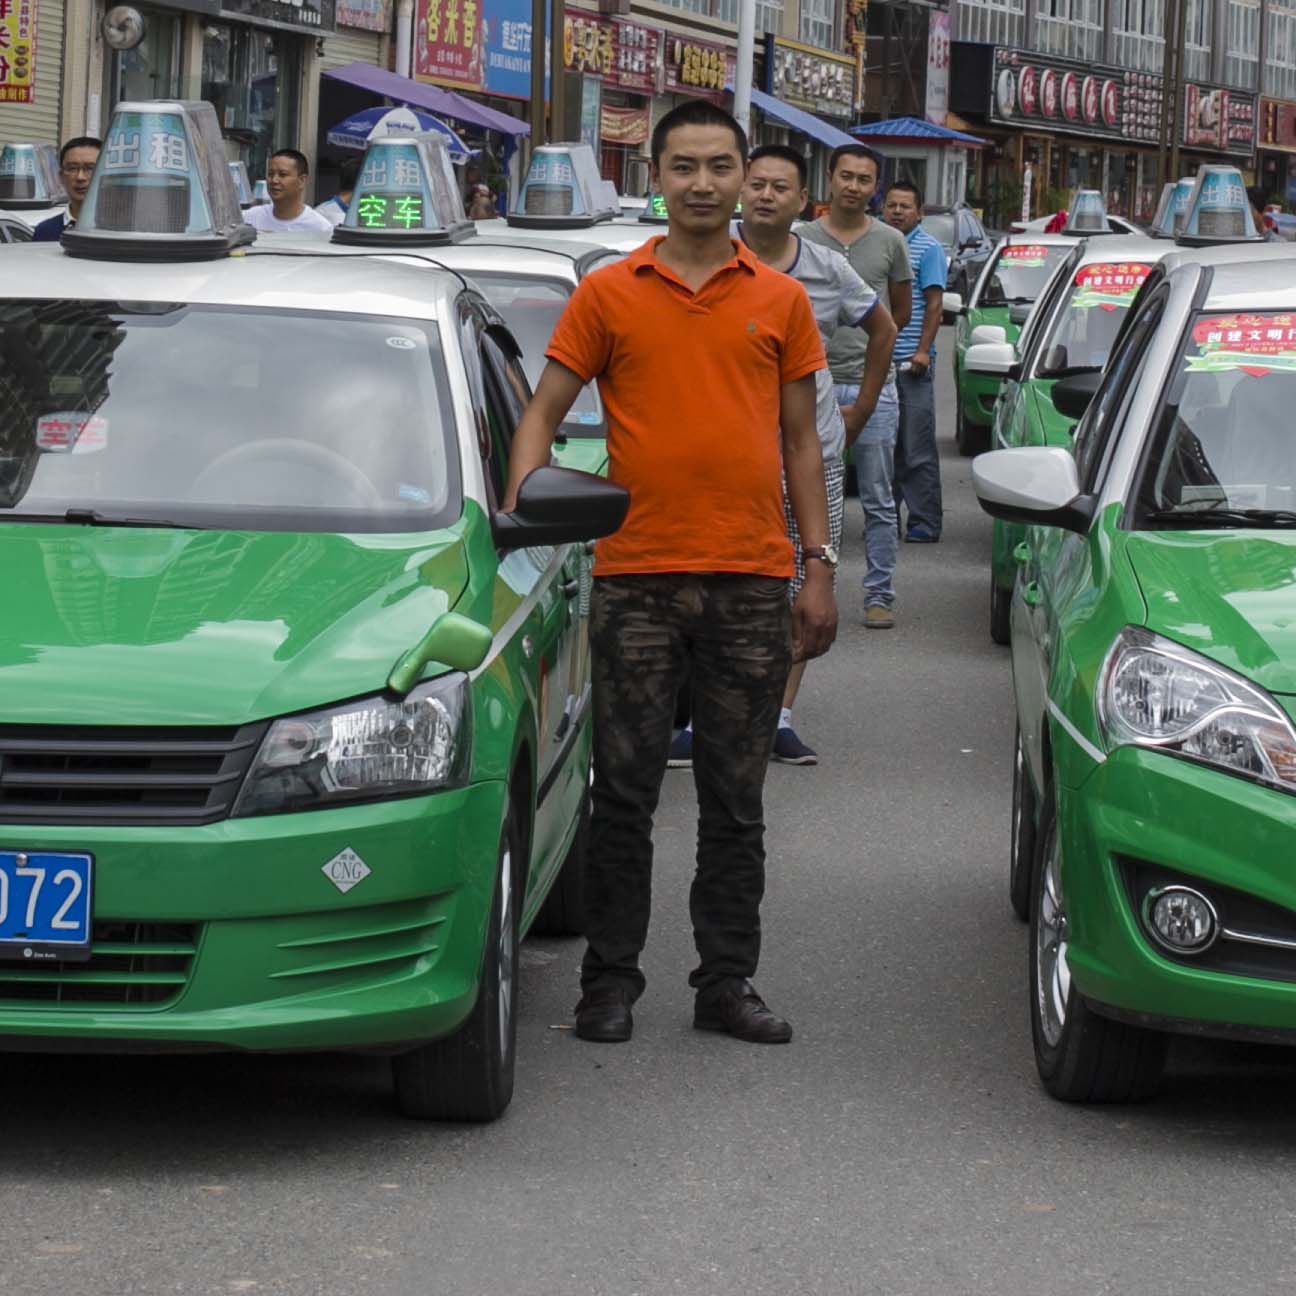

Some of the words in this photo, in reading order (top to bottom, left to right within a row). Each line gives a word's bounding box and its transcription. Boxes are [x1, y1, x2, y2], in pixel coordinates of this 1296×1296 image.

[104, 132, 190, 171] 出租
[360, 158, 422, 188] 出租
[529, 162, 573, 183] 出租
[1201, 184, 1246, 205] 出租
[358, 194, 423, 229] 空车
[331, 860, 363, 879] CNG
